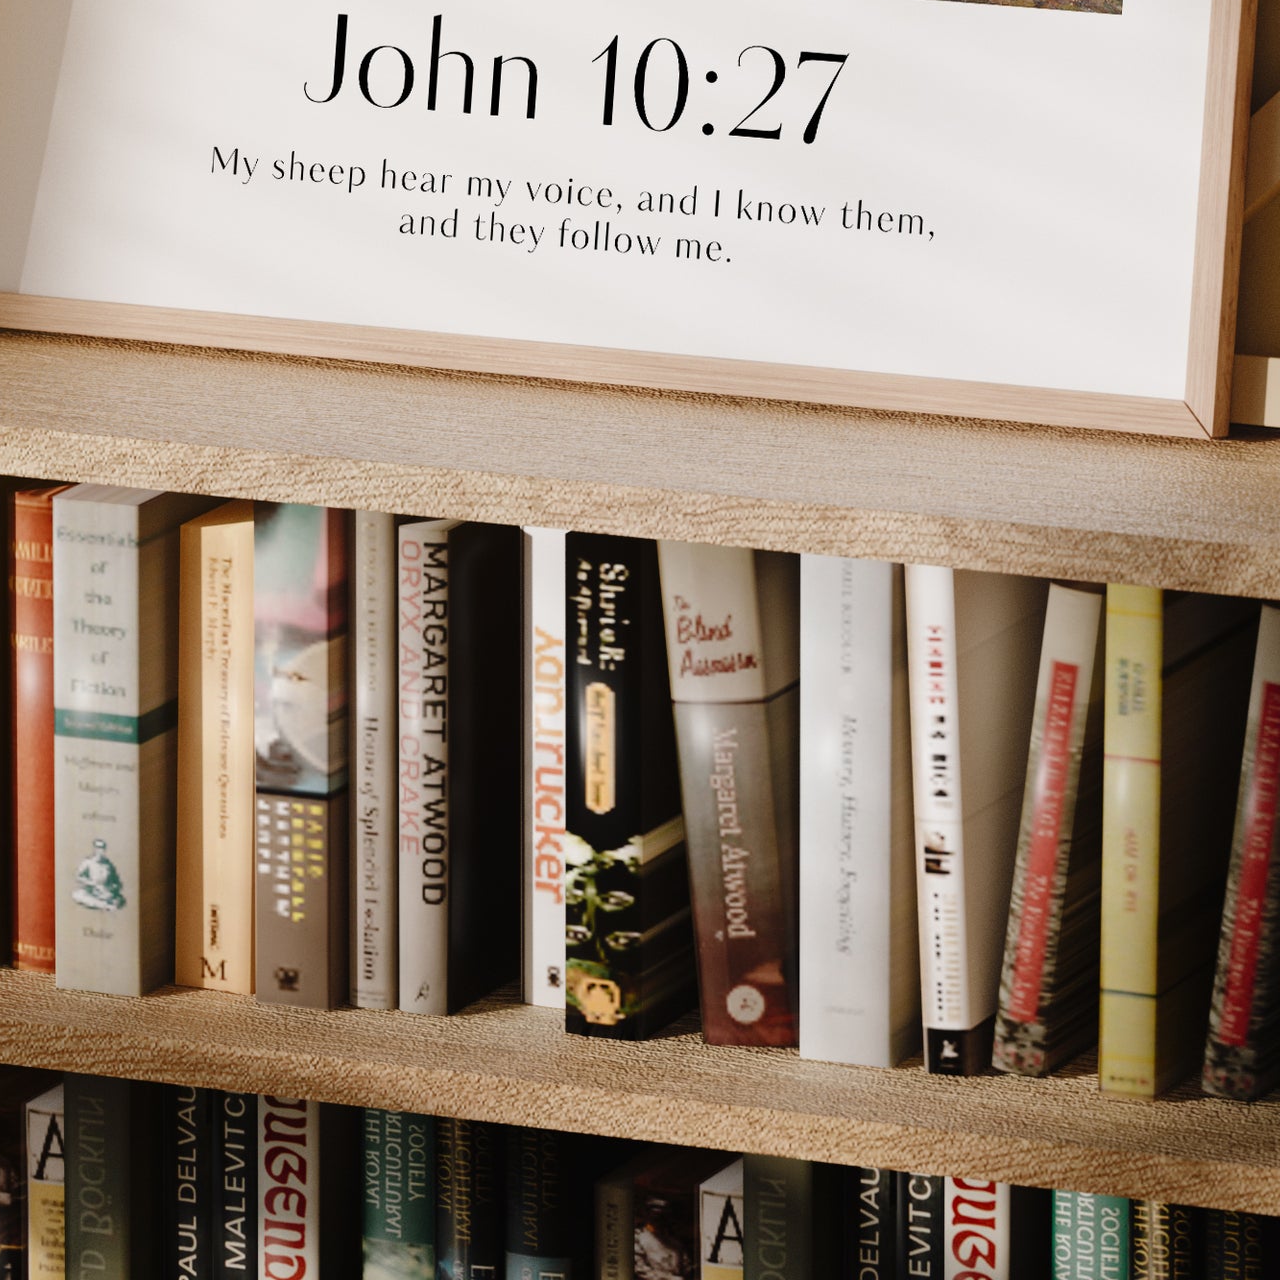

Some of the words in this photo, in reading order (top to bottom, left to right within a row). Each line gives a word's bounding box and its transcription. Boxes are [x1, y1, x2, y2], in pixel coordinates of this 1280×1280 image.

[303, 12, 541, 120] John
[590, 33, 850, 145] 10:27
[211, 146, 259, 184] My
[272, 151, 367, 192] sheep
[380, 159, 453, 195] hear
[467, 173, 511, 207] my
[525, 178, 623, 215] voice,
[638, 184, 698, 217] and
[714, 190, 721, 218] I
[737, 191, 824, 225] know
[840, 201, 937, 242] them,
[398, 207, 459, 240] and
[473, 213, 545, 253] they
[558, 219, 661, 257] follow
[675, 236, 732, 263] me.
[90, 560, 110, 576] of
[401, 539, 422, 639] ORYX
[70, 617, 127, 642] Theory
[90, 649, 111, 666] of
[423, 542, 448, 743] MARGARET
[401, 644, 421, 728] AND
[401, 735, 420, 855] CRAKE
[422, 754, 447, 905] ATWOOD
[711, 726, 741, 838] Margaret
[720, 841, 758, 940] Atwood
